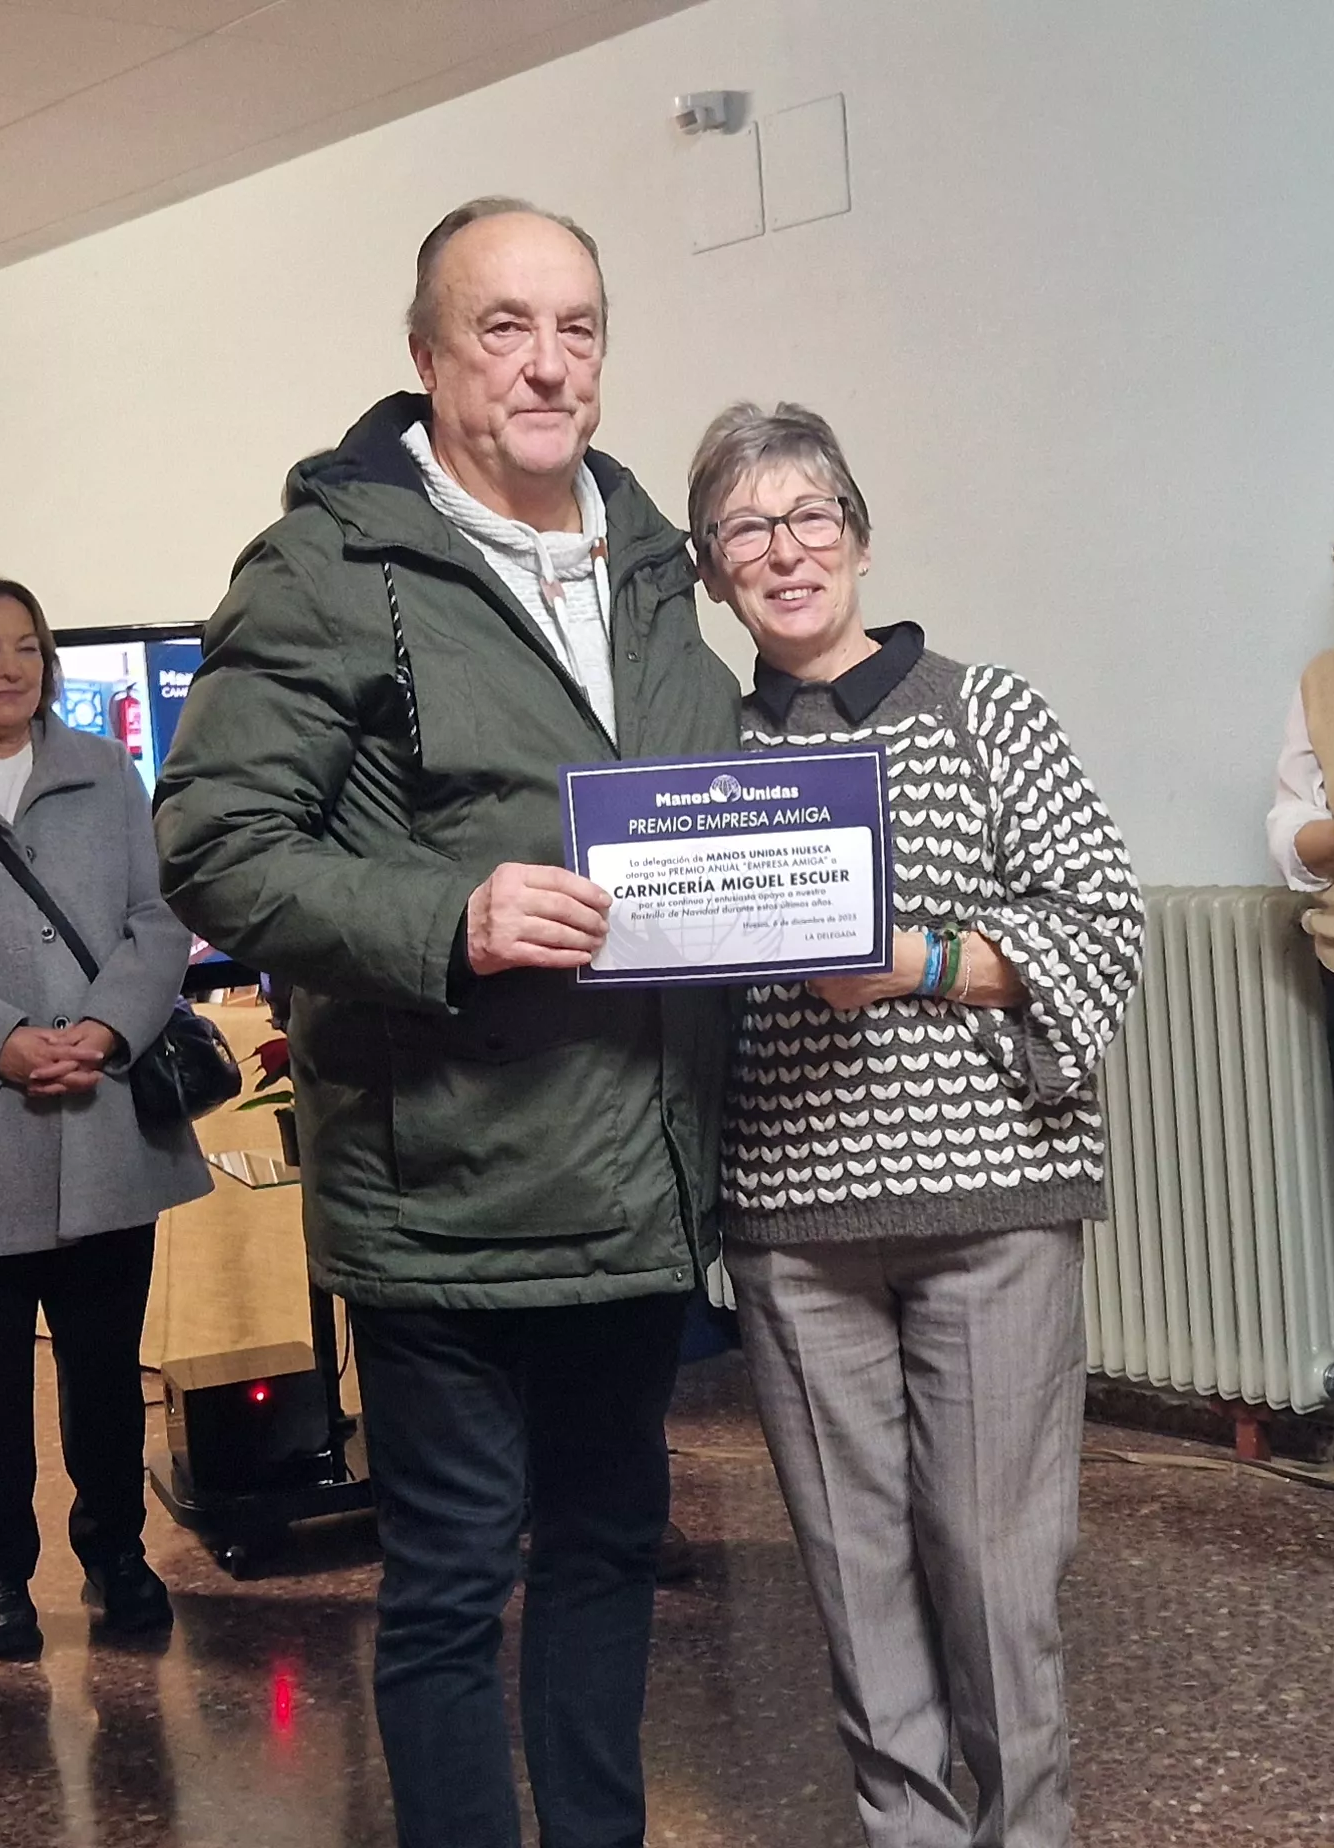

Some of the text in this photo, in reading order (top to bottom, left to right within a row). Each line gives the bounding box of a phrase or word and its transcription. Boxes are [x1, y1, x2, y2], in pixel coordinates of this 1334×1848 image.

[159, 669, 194, 686] Man
[655, 785, 800, 808] Manos Unidas
[628, 806, 832, 836] PREMIO EMPRESA AMIGA
[629, 844, 832, 868] La delegación de MANOS UNIDAS HUESCA
[625, 871, 655, 880] otorga
[657, 870, 666, 878] su
[668, 866, 705, 876] PREMIO
[708, 863, 740, 873] ANUAL
[613, 869, 850, 899] CARNICERÍA MIGUEL ESCUER
[639, 902, 653, 910] por
[758, 892, 785, 902] apoyo
[795, 888, 827, 897] nuestro
[630, 910, 665, 920] Rastrillo
[668, 910, 679, 918] de
[682, 906, 720, 917] Navidad
[722, 904, 755, 914] durante
[757, 901, 778, 911] estos
[805, 930, 857, 941] LA DELEGADA
